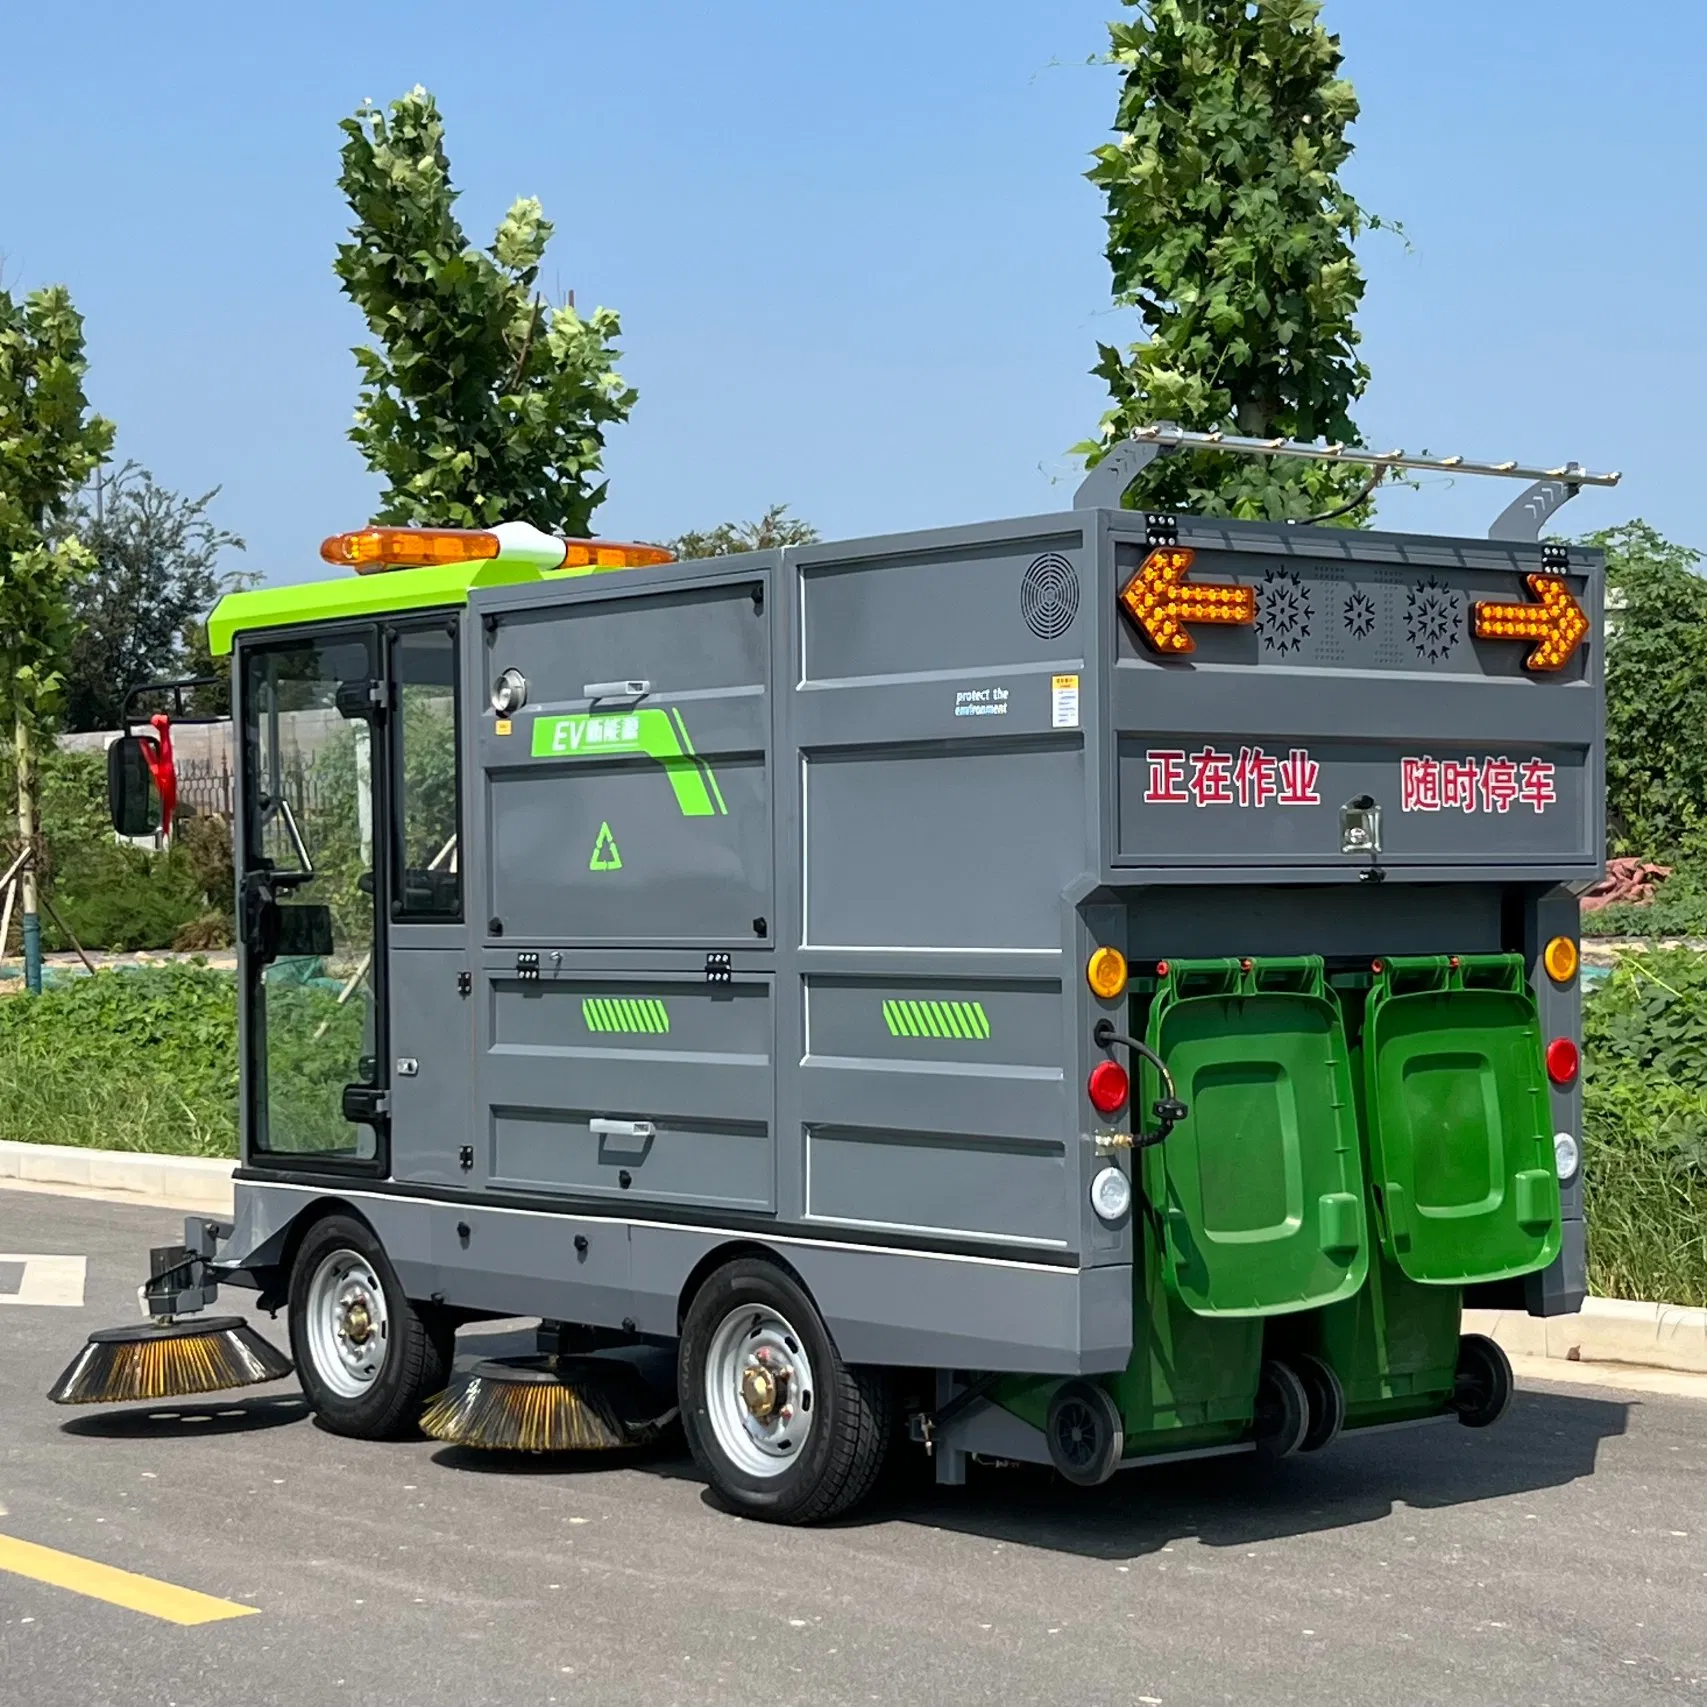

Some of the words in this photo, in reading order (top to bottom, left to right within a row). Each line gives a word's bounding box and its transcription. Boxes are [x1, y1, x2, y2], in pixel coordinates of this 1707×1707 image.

[956, 689, 990, 705] protect
[993, 687, 1009, 700] the
[1144, 745, 1320, 807] 正在作业
[1401, 754, 1557, 813] 随时停车
